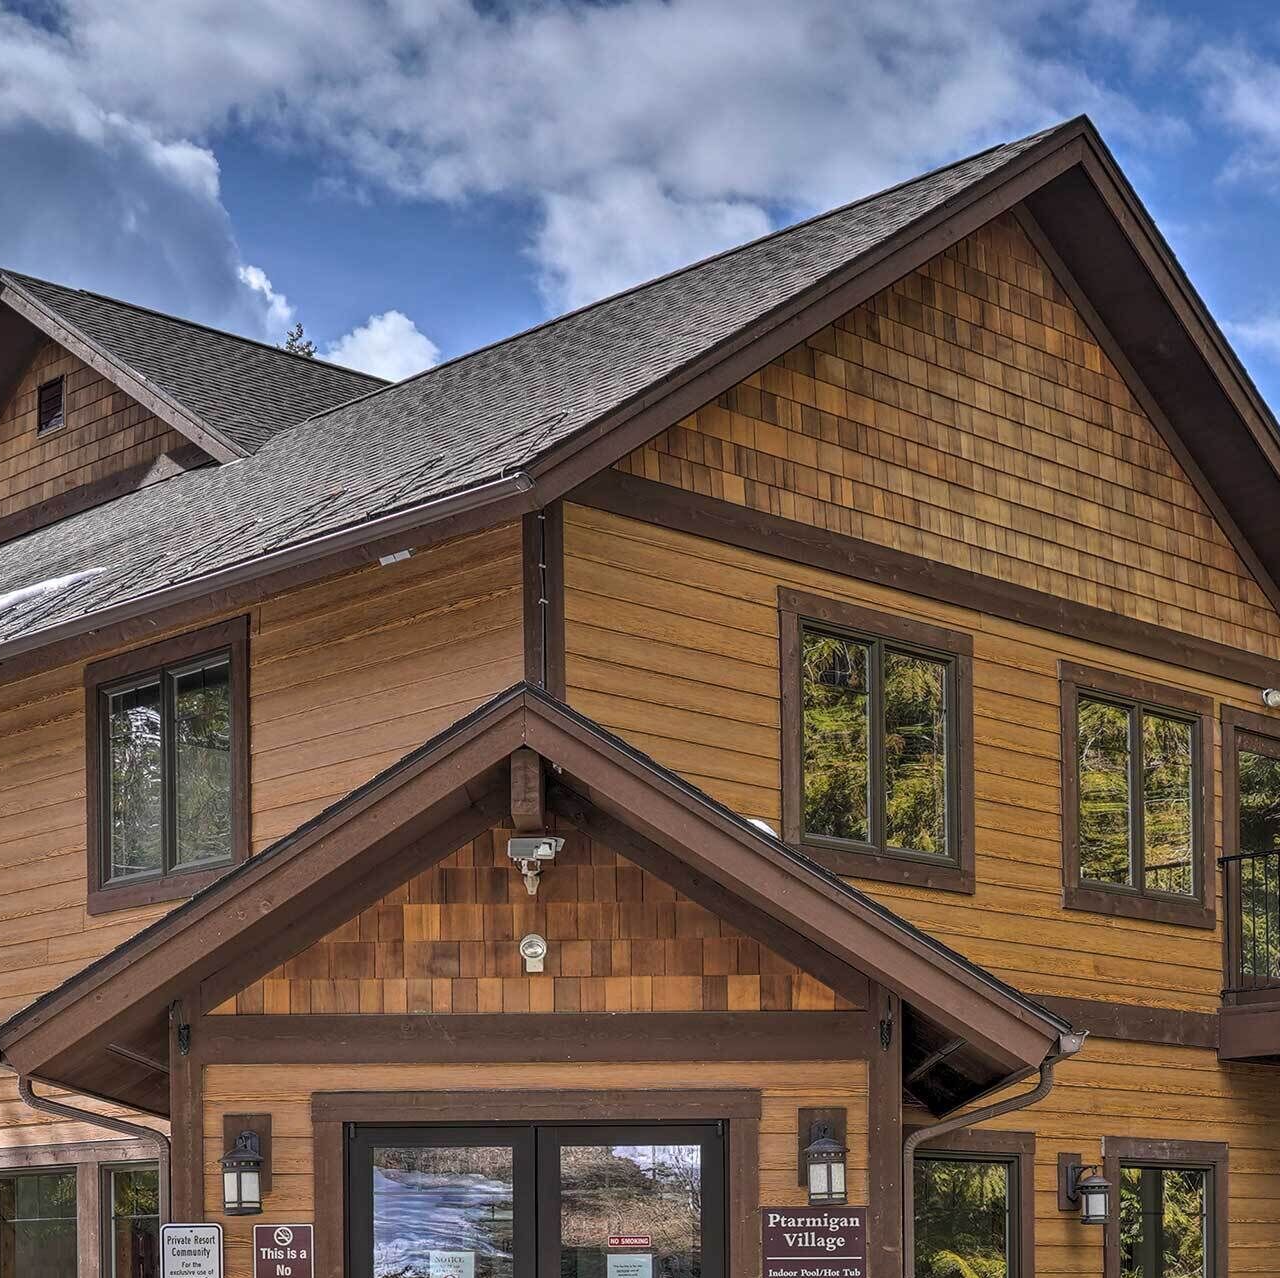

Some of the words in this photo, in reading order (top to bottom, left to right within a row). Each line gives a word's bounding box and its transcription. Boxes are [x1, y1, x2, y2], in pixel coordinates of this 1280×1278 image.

[768, 1213, 860, 1232] Ptarmigan
[167, 1235, 191, 1245] Private
[194, 1235, 216, 1245] Resort
[783, 1232, 846, 1251] Village
[172, 1248, 211, 1258] Community
[260, 1247, 284, 1259] This
[287, 1247, 297, 1259] is
[300, 1249, 307, 1259] a
[276, 1264, 292, 1276] No
[768, 1269, 798, 1277] Indoor
[801, 1268, 840, 1277] Pool/Hot
[843, 1268, 861, 1277] Tub
